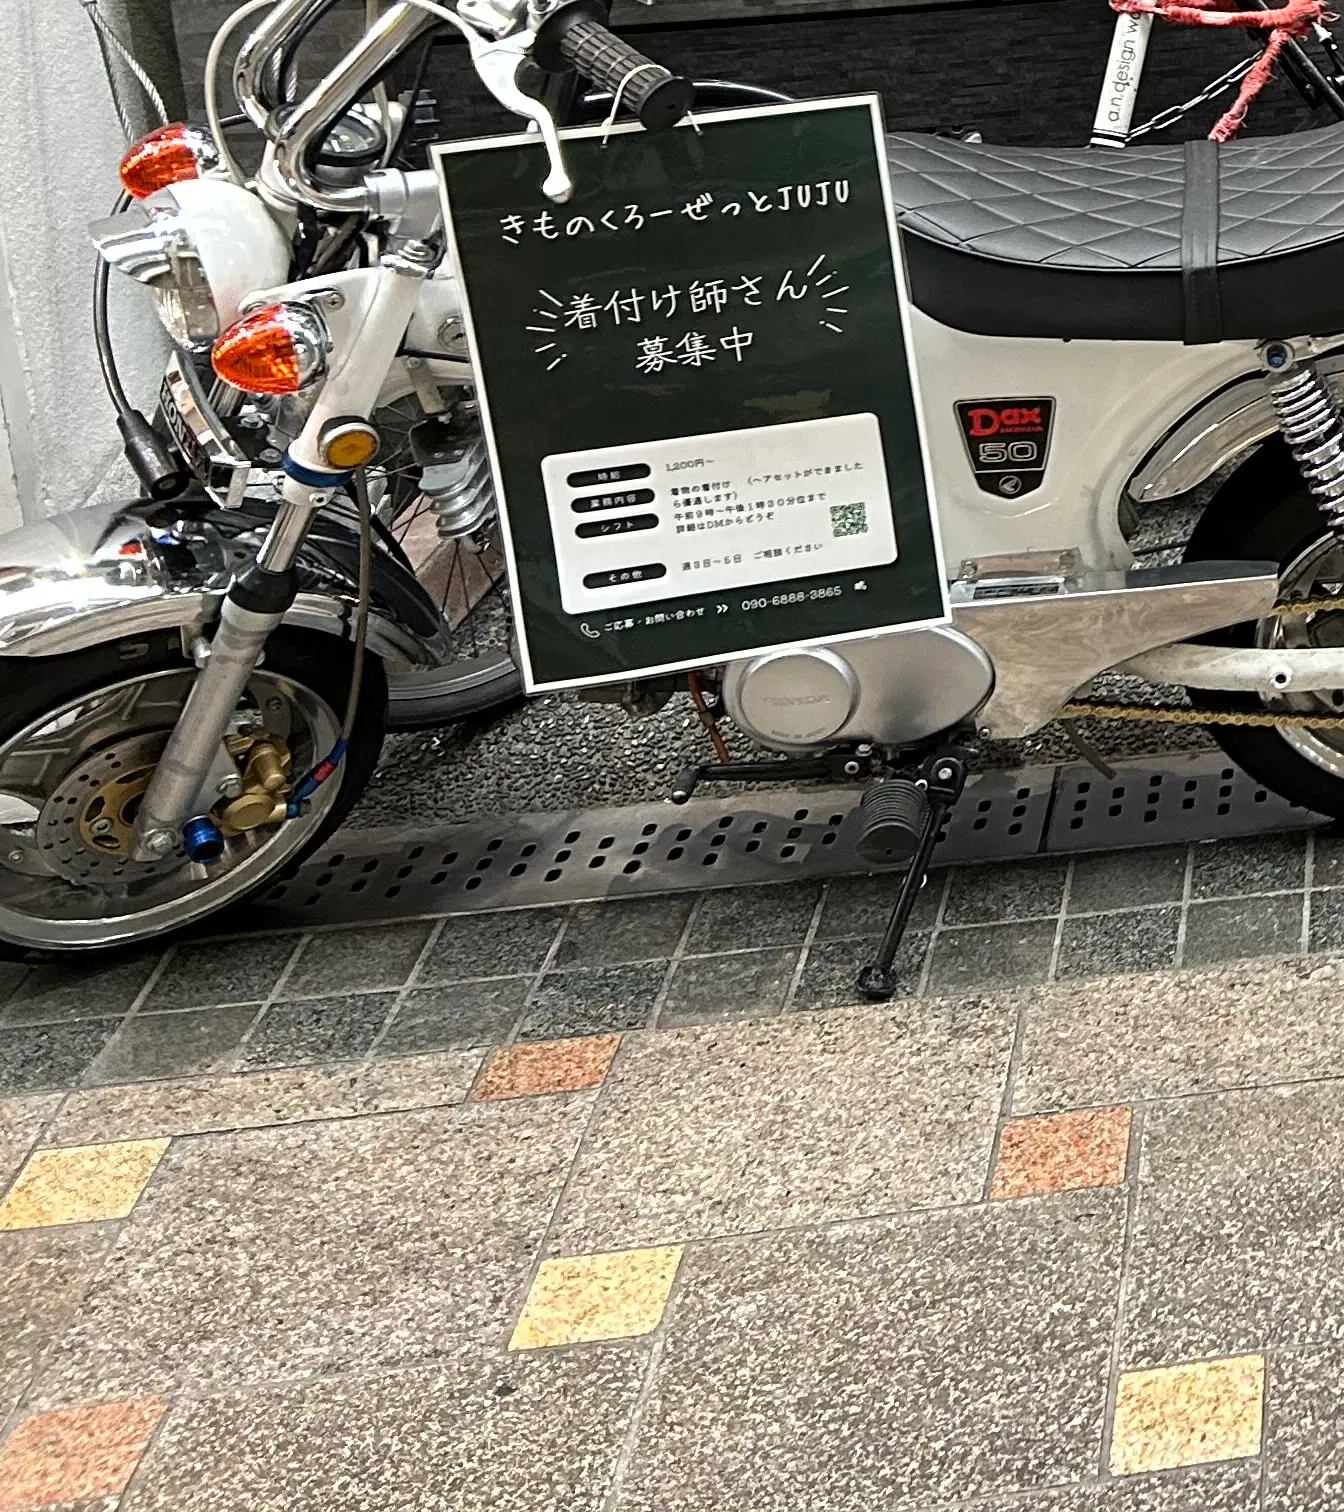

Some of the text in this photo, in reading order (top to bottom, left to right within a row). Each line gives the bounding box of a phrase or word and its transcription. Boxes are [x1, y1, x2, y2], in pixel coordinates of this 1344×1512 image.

[564, 270, 808, 330] 着付け師さん
[635, 326, 754, 374] 募集中
[967, 407, 1042, 437] Dax
[978, 441, 1038, 463] 50
[601, 520, 634, 533] シフト
[608, 569, 643, 583] その他
